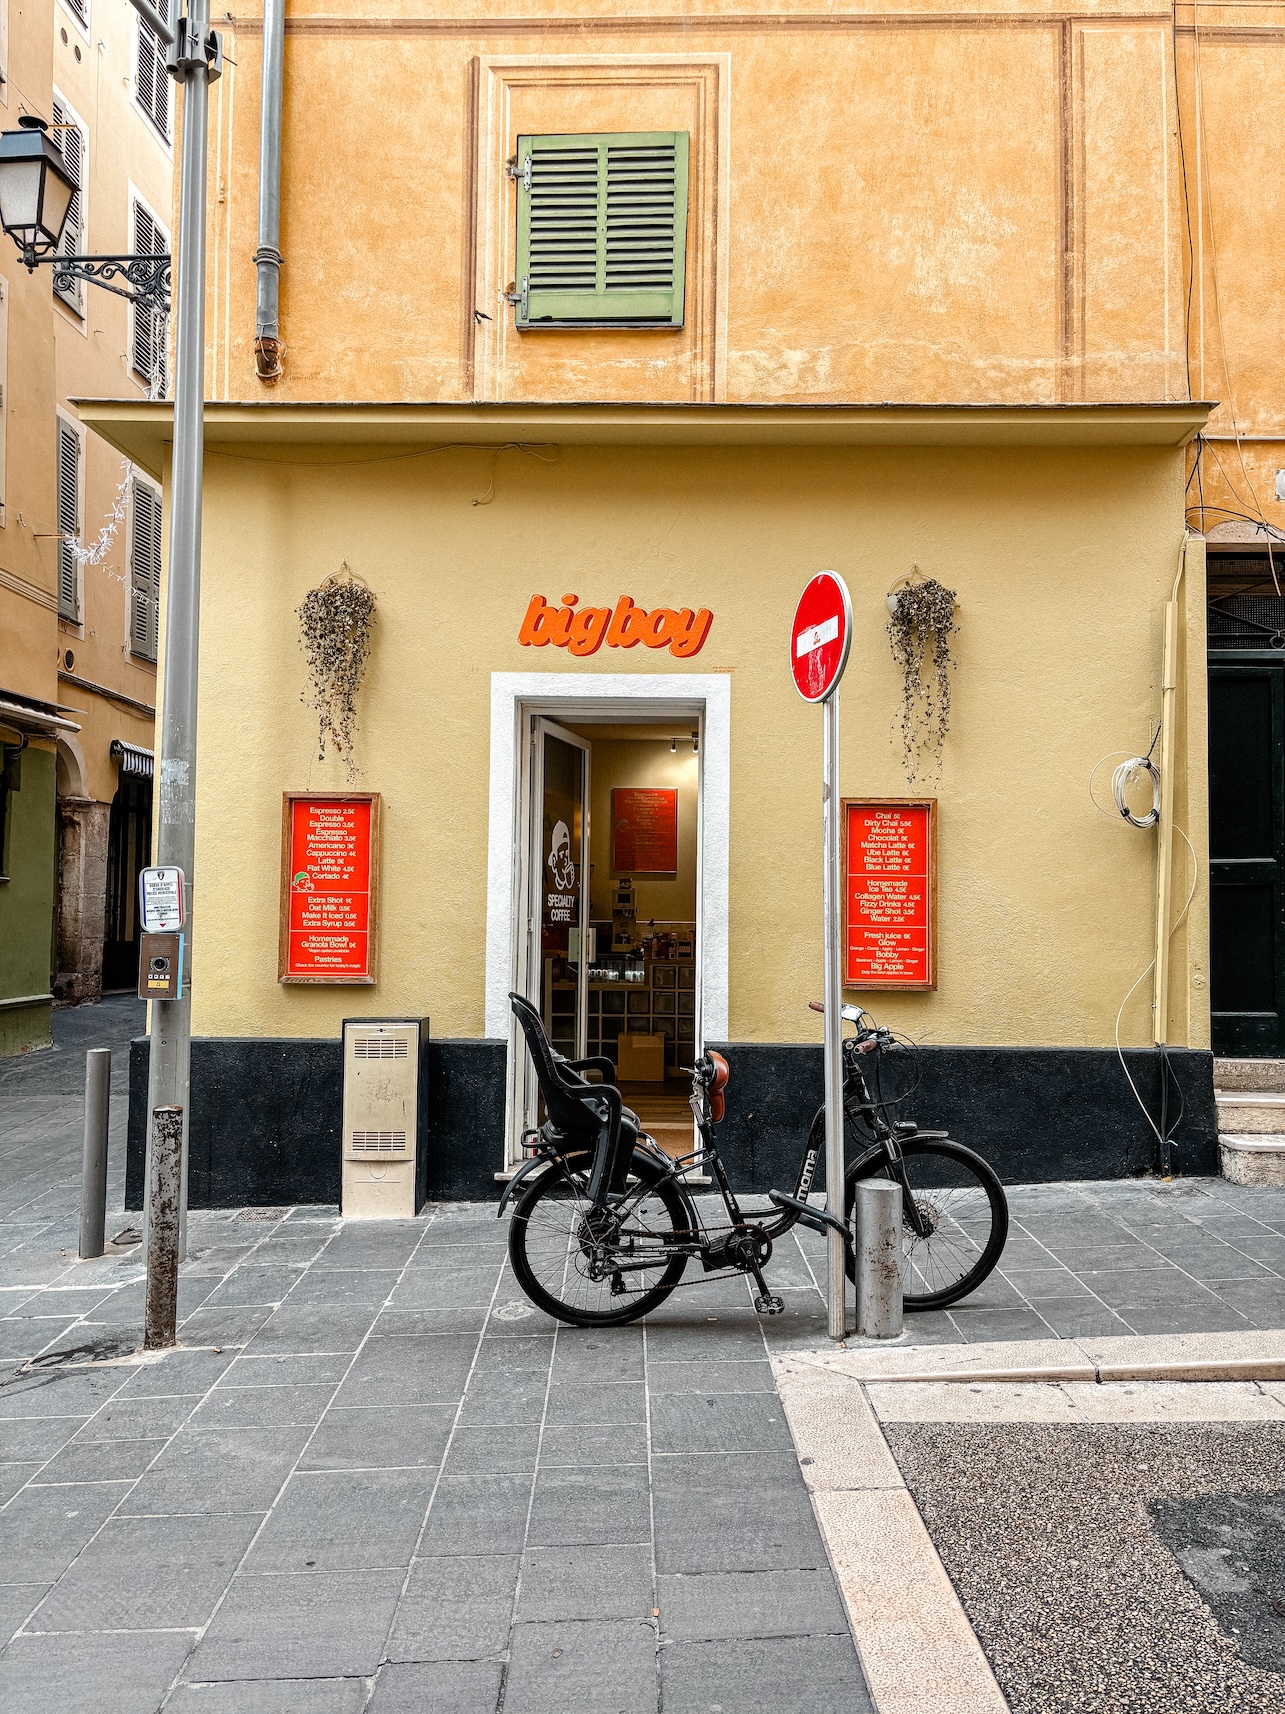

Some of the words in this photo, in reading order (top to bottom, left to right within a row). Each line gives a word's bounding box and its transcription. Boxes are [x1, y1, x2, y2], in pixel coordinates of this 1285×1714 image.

[548, 894, 575, 908] SPECIALTY
[550, 909, 571, 922] COFFEE
[796, 1149, 817, 1204] moma
